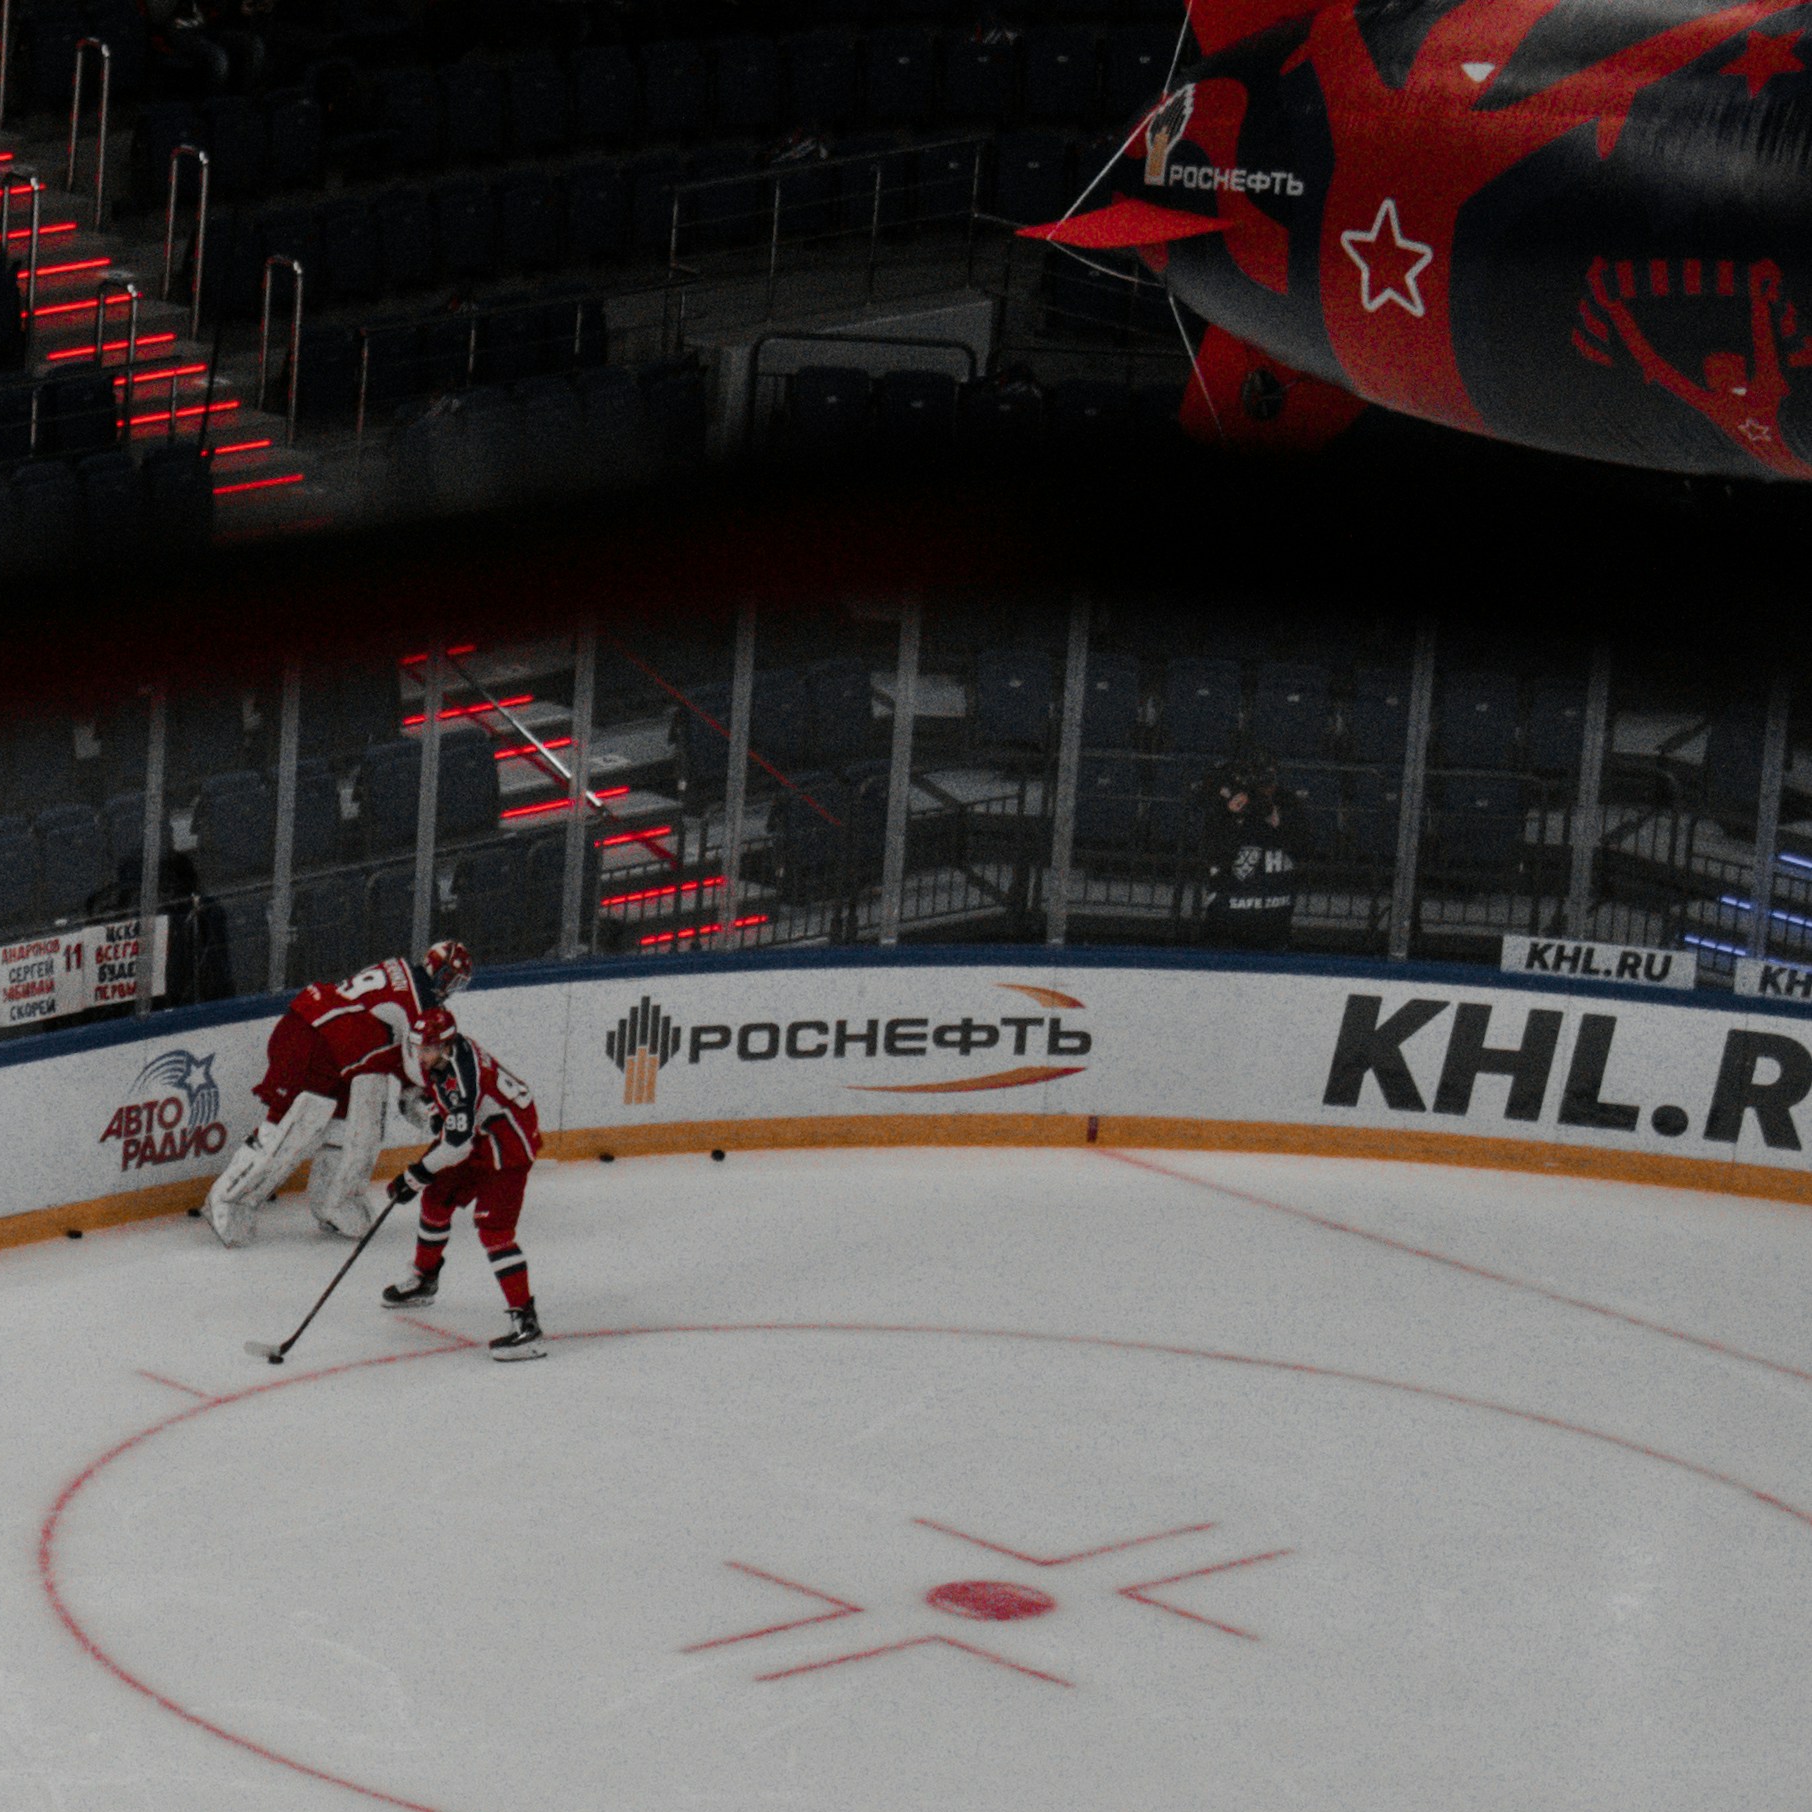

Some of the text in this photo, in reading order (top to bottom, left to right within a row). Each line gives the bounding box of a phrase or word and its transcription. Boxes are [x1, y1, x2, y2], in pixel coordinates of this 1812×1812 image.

[1168, 164, 1305, 198] РОСНЕФТЬ
[98, 961, 138, 983] БУДЕ
[1524, 941, 1673, 982] KHL.RU
[1757, 962, 1812, 999] KH
[688, 1014, 1093, 1066] РОСНЕФТЬ
[1322, 993, 1812, 1152] KHL.R
[99, 1096, 184, 1143] АВТО
[120, 1121, 228, 1173] РАДИО
